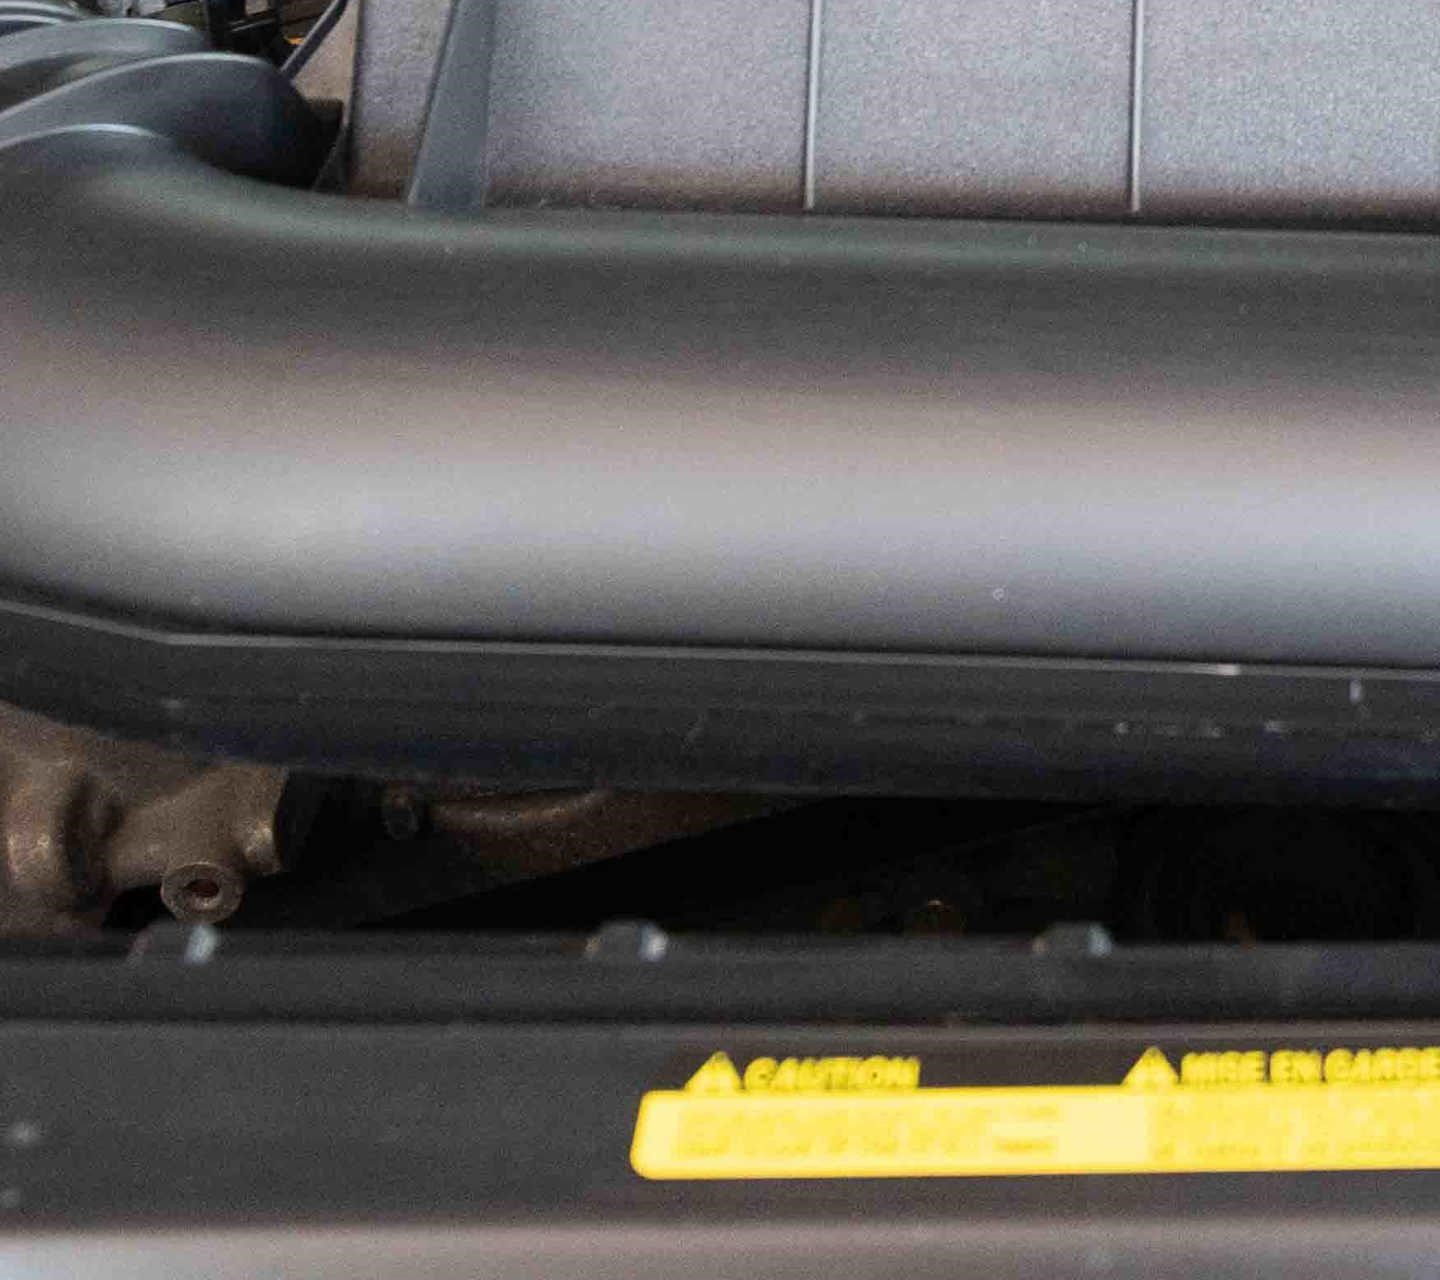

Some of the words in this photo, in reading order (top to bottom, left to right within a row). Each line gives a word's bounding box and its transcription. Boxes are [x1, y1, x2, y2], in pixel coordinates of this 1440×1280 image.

[744, 1056, 920, 1091] CAUTION
[1181, 1052, 1265, 1082] MISE
[1270, 1051, 1321, 1081] EN
